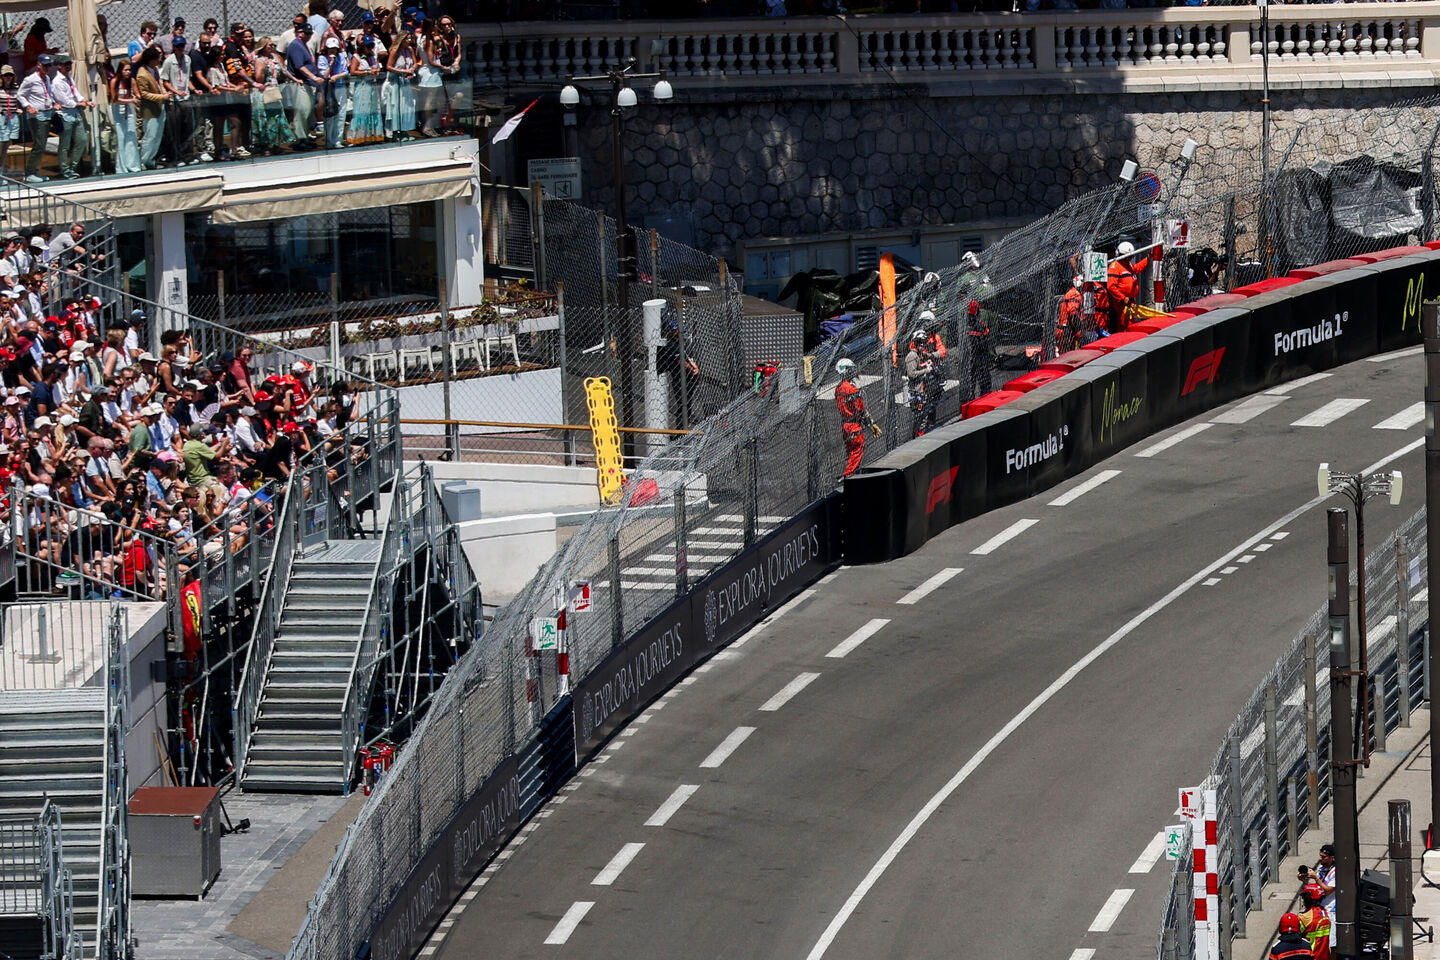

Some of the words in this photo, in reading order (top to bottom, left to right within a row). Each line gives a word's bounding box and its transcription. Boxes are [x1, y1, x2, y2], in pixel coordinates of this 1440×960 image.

[1274, 319, 1333, 356] Formula
[1100, 381, 1143, 445] Monaco
[1006, 433, 1058, 474] Formula
[718, 566, 766, 625] EXPLORA
[766, 523, 819, 600] JOURNEYS
[592, 674, 637, 728] EXPLORA
[635, 621, 683, 696] JOURNEYS
